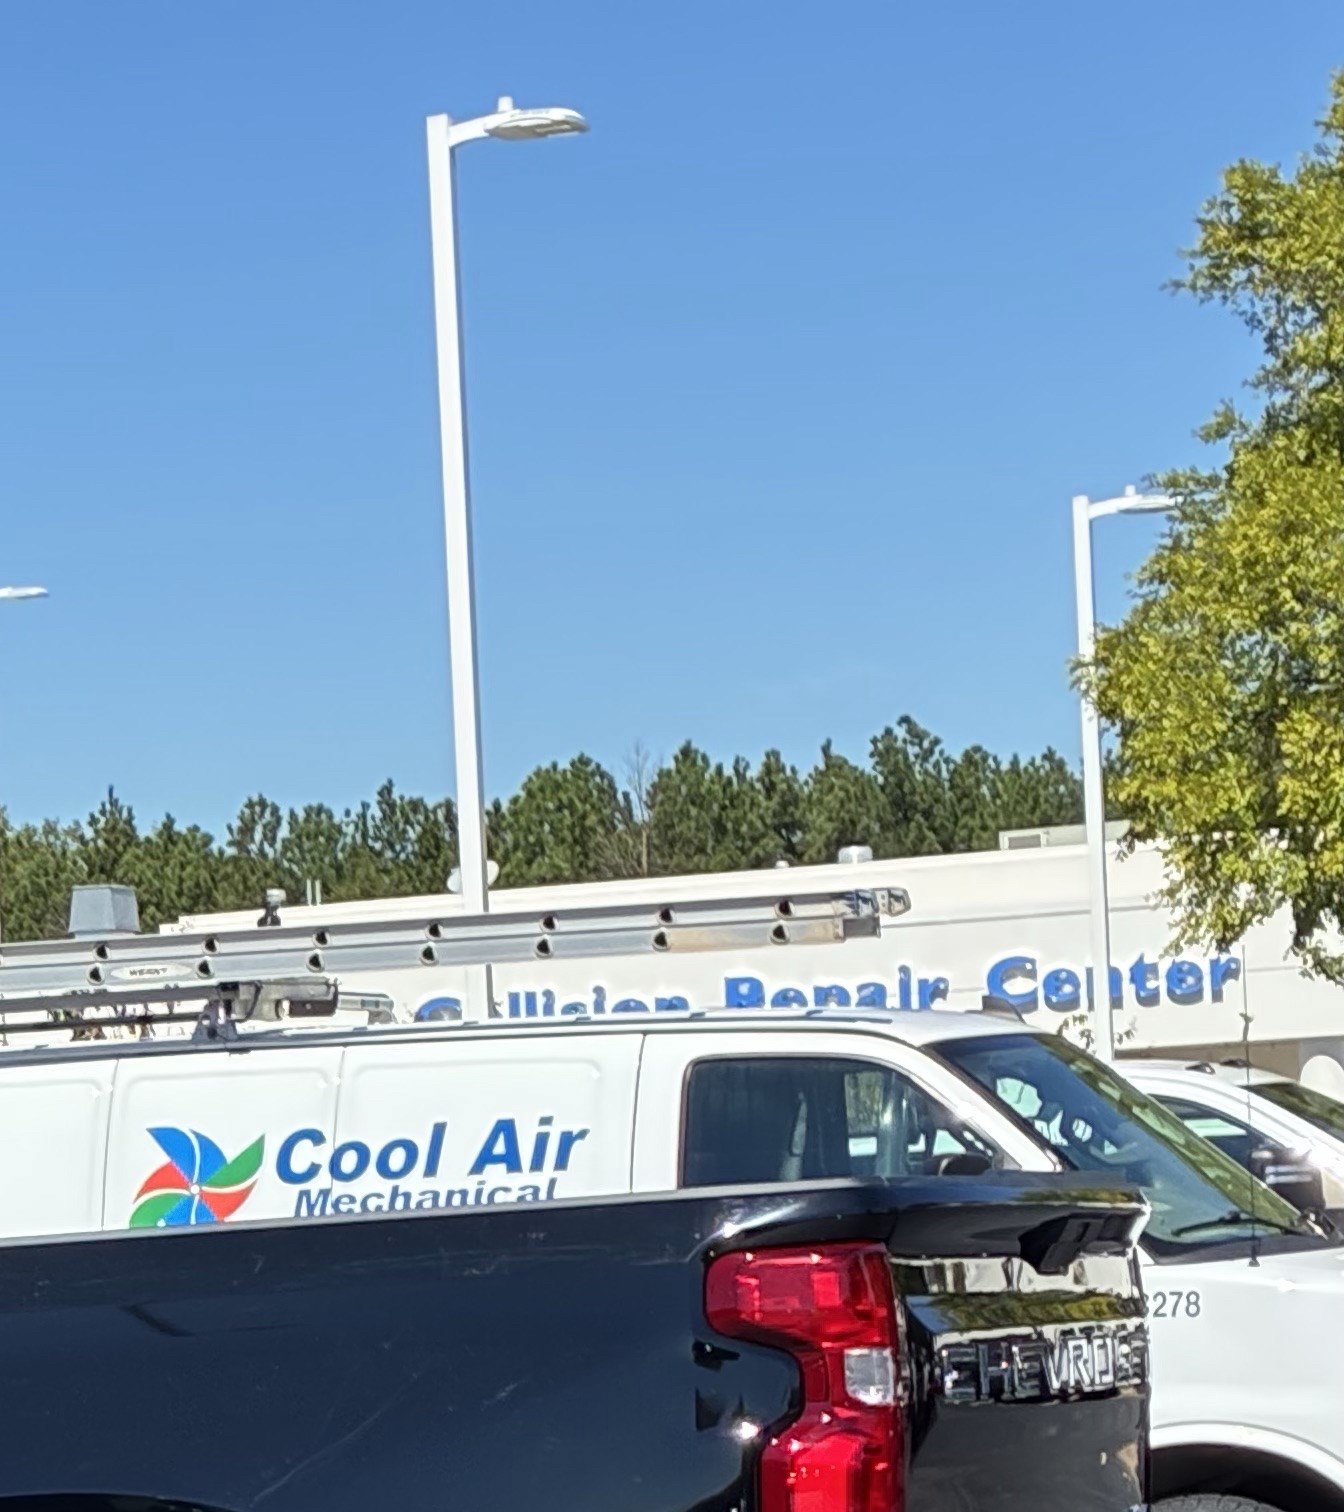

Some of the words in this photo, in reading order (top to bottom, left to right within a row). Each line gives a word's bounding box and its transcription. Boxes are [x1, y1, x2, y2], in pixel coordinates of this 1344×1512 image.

[413, 985, 690, 1022] Cllision
[276, 1121, 448, 1185] Cool
[467, 1115, 591, 1177] Air
[293, 1177, 558, 1219] Mechanical
